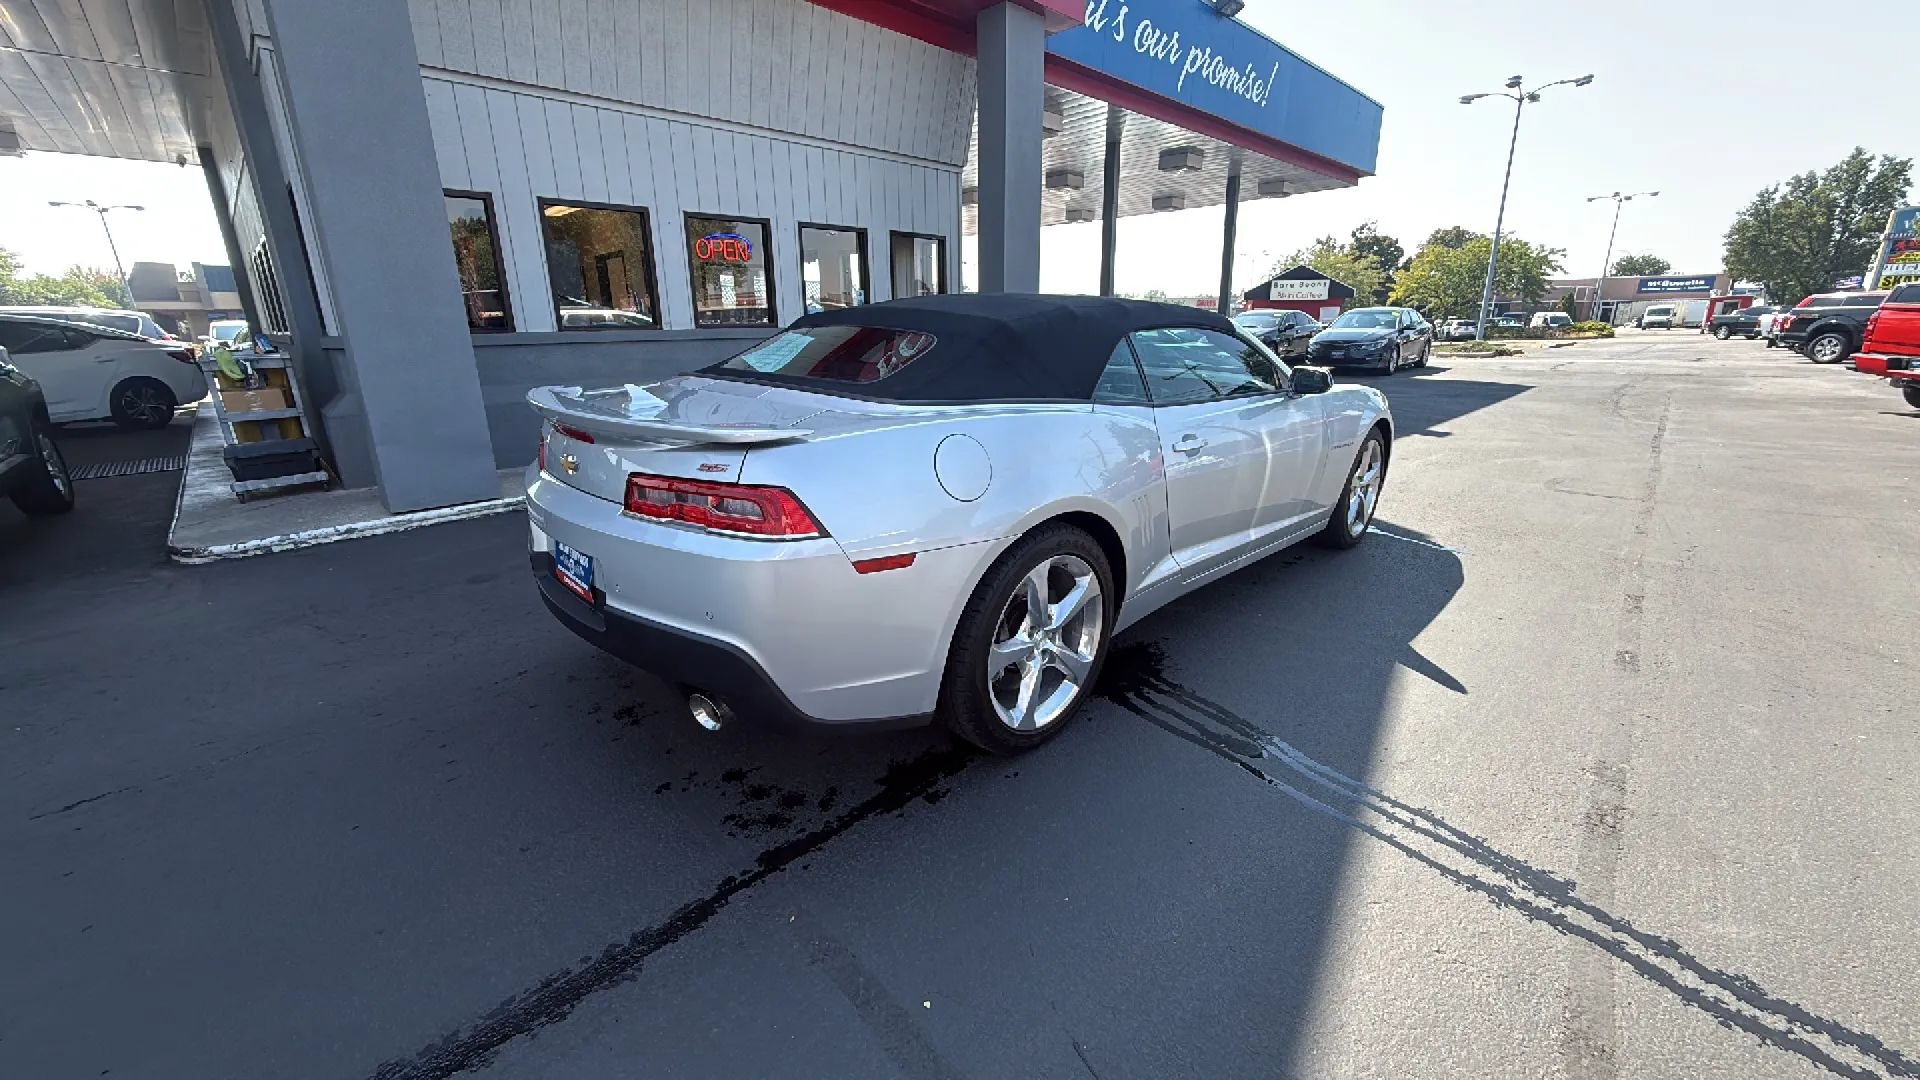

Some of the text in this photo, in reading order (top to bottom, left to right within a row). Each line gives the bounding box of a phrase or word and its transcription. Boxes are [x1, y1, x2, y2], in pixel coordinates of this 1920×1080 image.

[1134, 19, 1181, 64] our
[1177, 45, 1279, 107] promise!
[696, 238, 749, 262] OPEN
